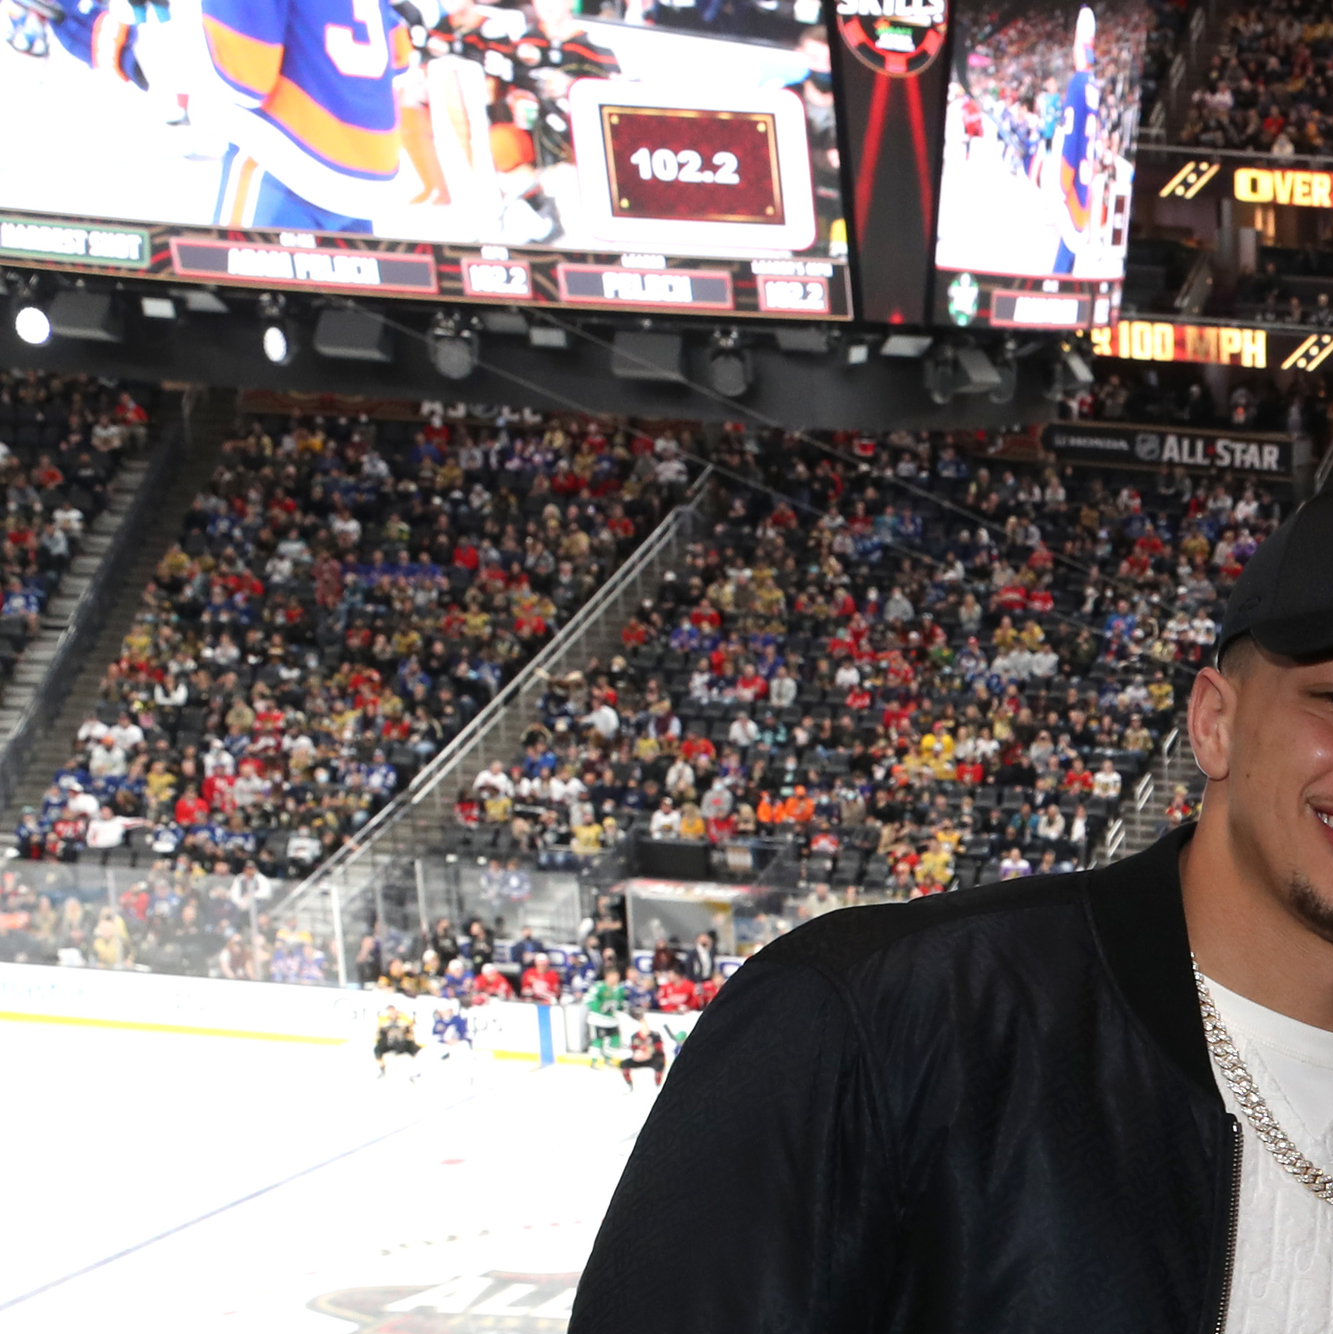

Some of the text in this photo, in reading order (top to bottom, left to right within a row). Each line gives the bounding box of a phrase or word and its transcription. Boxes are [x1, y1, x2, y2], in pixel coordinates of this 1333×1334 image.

[630, 147, 741, 185] 102.2
[1234, 168, 1332, 208] OVER
[1118, 321, 1175, 361] 100
[1187, 325, 1267, 368] MPH
[1161, 433, 1211, 465] ALL
[1214, 438, 1280, 471] STAR
